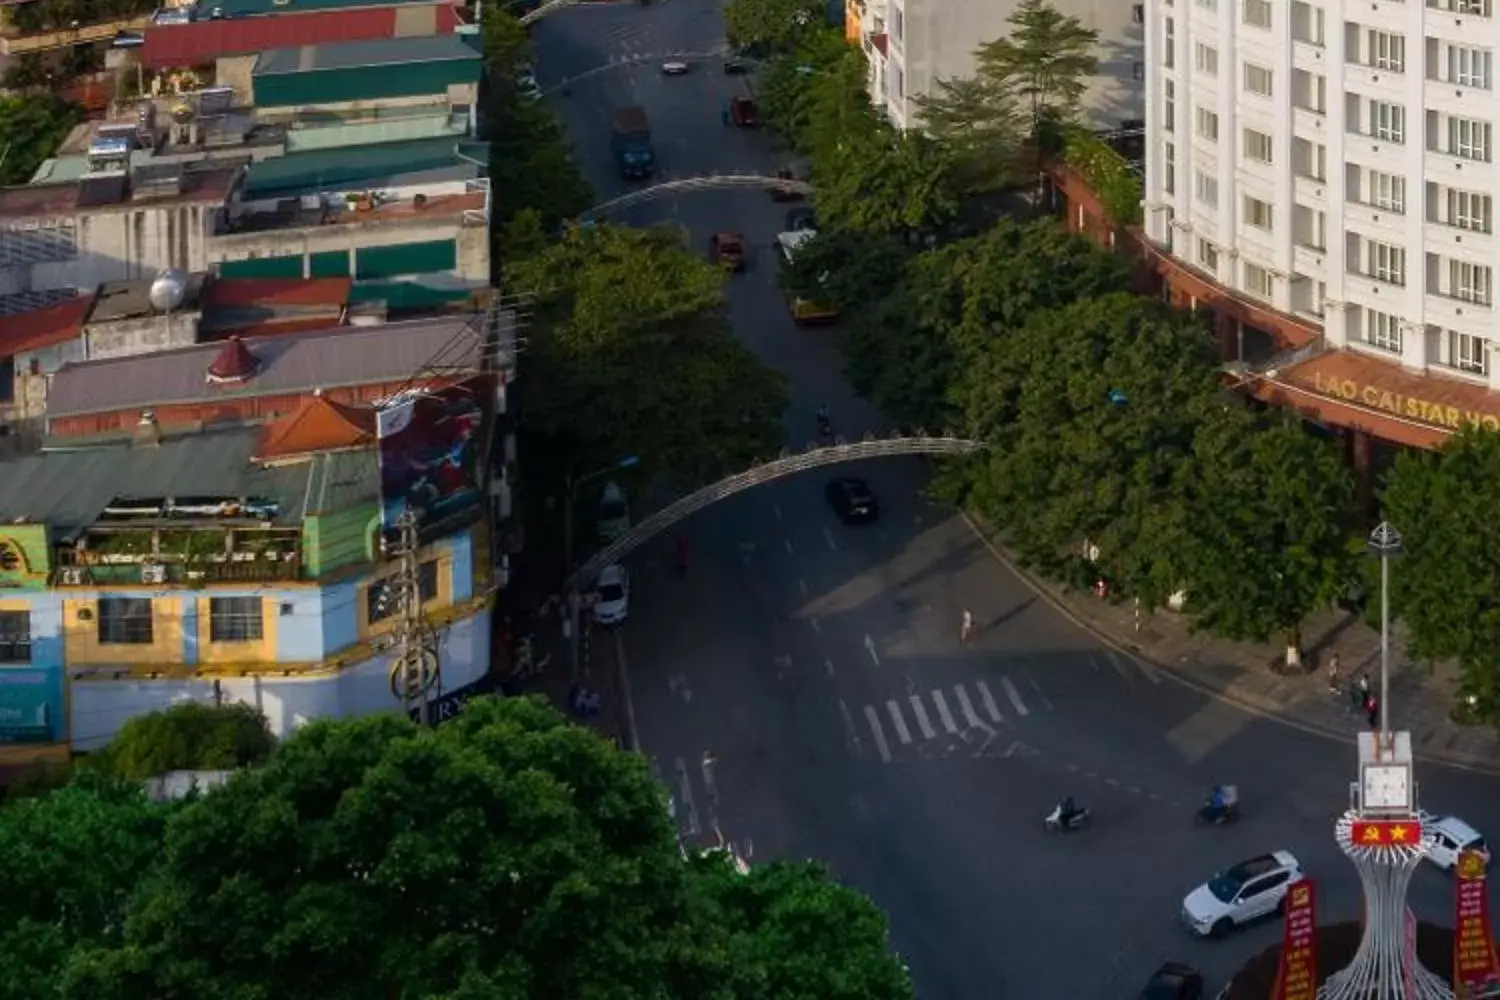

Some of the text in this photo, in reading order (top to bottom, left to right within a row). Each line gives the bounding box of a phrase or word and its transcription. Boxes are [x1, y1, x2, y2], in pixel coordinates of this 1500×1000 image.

[1315, 369, 1358, 400] LAO
[1362, 385, 1402, 415] CAI
[1407, 397, 1460, 429] STAR
